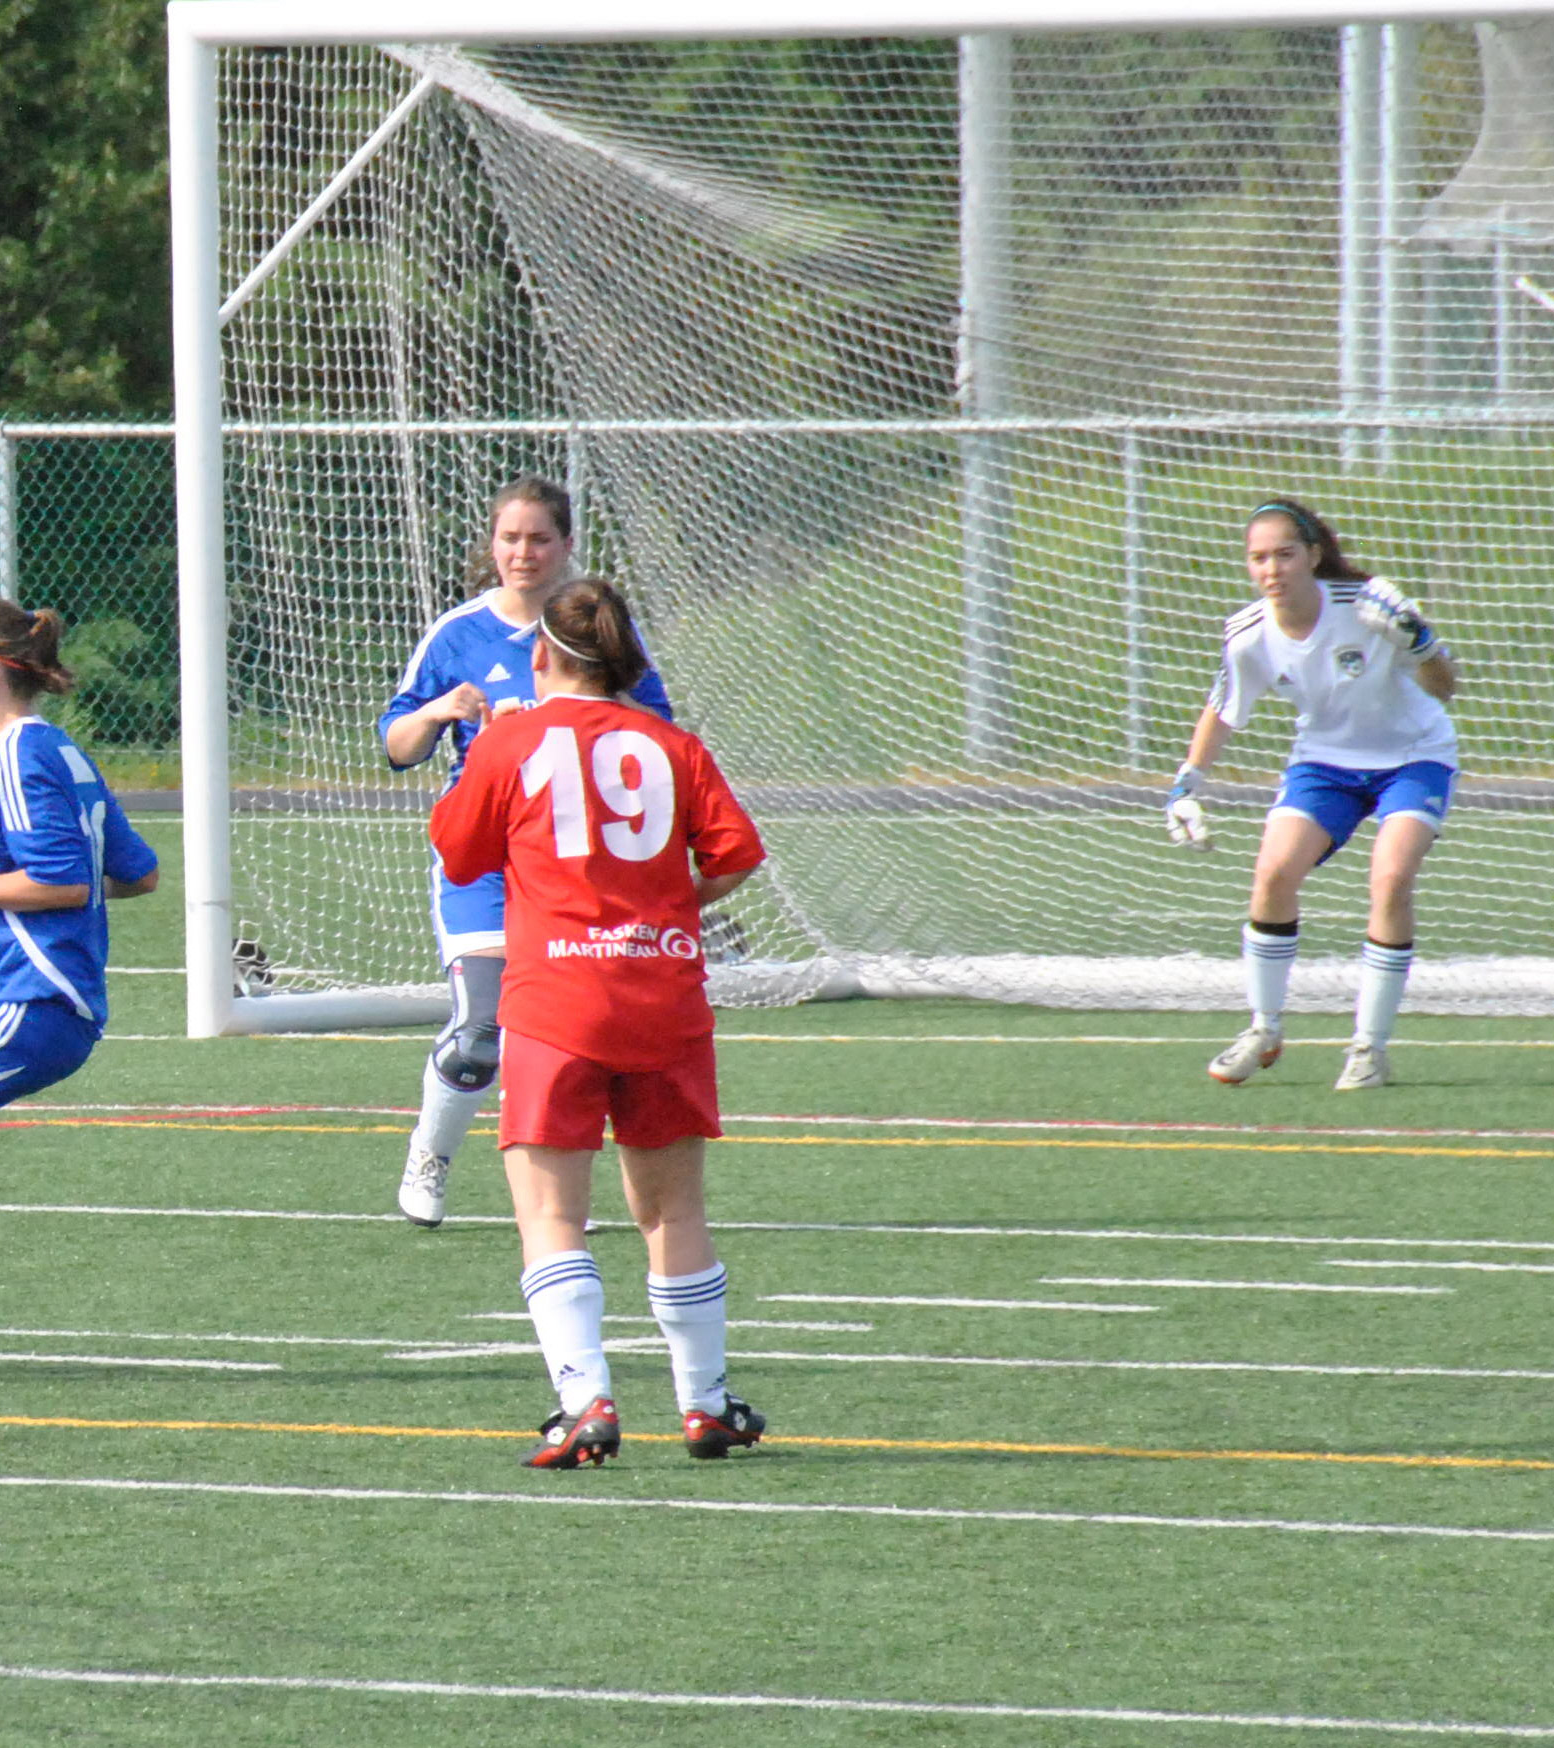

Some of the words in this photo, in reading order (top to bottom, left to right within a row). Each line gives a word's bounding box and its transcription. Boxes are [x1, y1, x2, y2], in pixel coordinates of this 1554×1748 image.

[520, 726, 676, 862] 19
[588, 924, 659, 941] FASKEN
[547, 938, 660, 959] MARTINEAU
